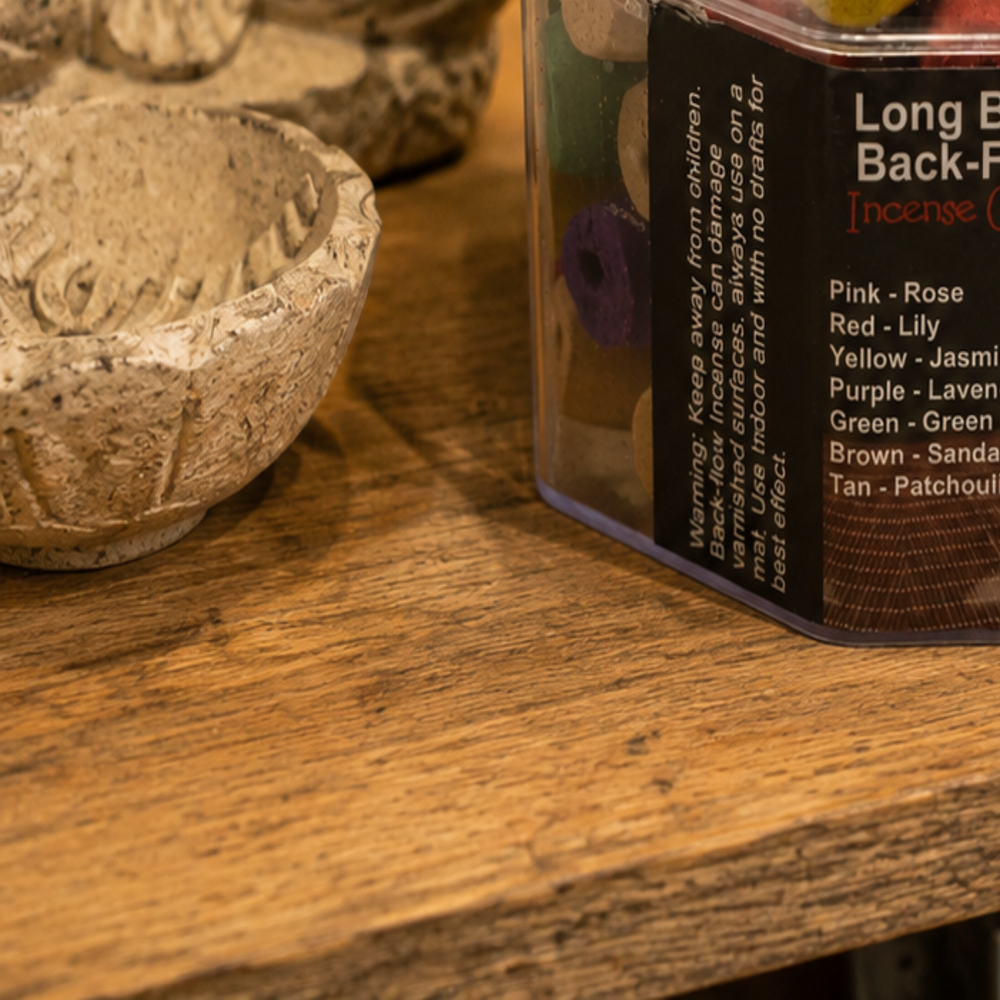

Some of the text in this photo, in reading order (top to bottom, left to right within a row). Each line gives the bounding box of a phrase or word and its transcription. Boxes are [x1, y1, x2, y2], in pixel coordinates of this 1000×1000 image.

[730, 84, 743, 101] a
[748, 74, 764, 112] for
[856, 92, 963, 141] Long
[730, 109, 743, 144] on
[730, 153, 744, 203] use
[748, 120, 765, 199] drafts
[708, 144, 726, 255] damage
[846, 191, 977, 234] Incense
[687, 206, 702, 269] from
[751, 208, 765, 243] no
[711, 263, 723, 311] can
[750, 250, 765, 304] with
[830, 279, 881, 304] Pink
[904, 281, 964, 303] Rose
[690, 277, 707, 348] away
[830, 312, 875, 337] Red
[899, 313, 940, 341] Lily
[750, 311, 766, 365] and
[829, 343, 907, 369] Yellow
[688, 354, 707, 425] Keep
[709, 320, 724, 424] Incense
[830, 377, 905, 408] Purple
[830, 409, 899, 434] Green
[923, 410, 993, 432] Green
[829, 440, 904, 465] Brown
[751, 463, 766, 516] Use
[829, 472, 871, 496] Tan
[771, 534, 786, 594] best
